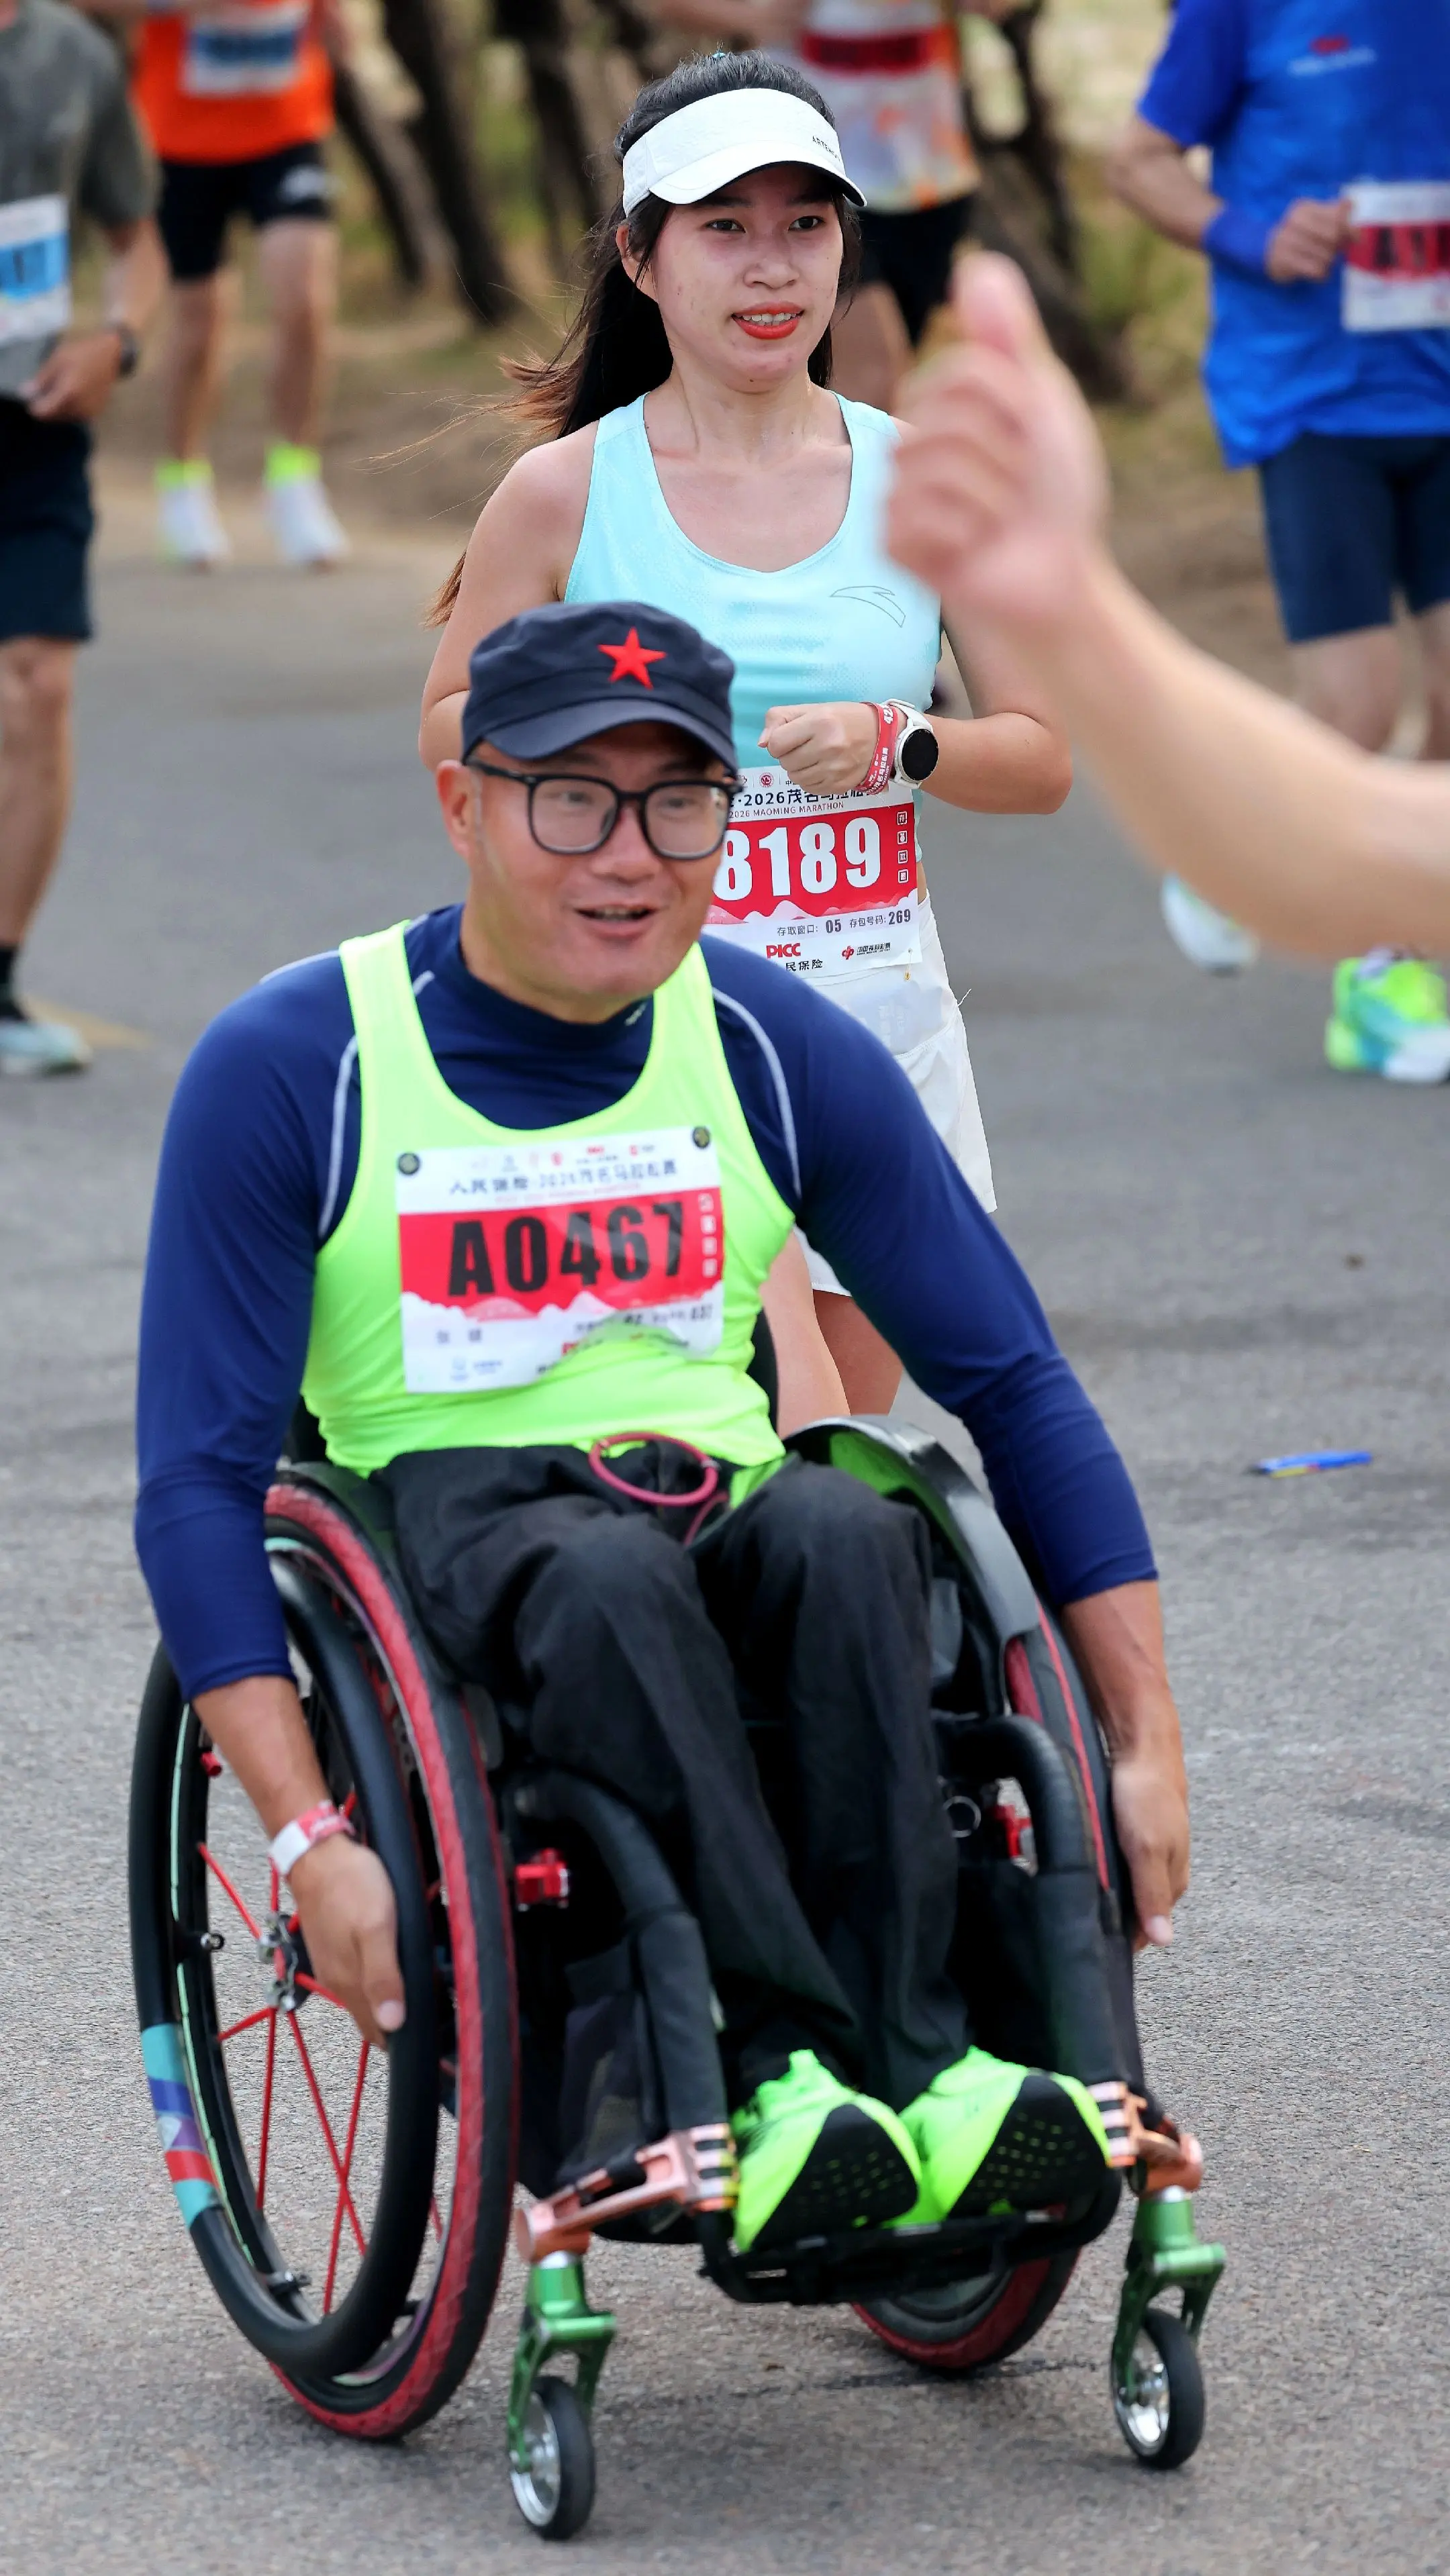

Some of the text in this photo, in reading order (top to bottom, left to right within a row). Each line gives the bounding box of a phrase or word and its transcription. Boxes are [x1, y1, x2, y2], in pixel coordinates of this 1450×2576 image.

[730, 801, 844, 819] 2026 MAOMING MARATHON
[712, 817, 881, 901] 8189
[826, 920, 842, 933] 05
[888, 909, 911, 925] 269
[766, 943, 801, 959] PICC
[448, 1201, 683, 1297] A0467
